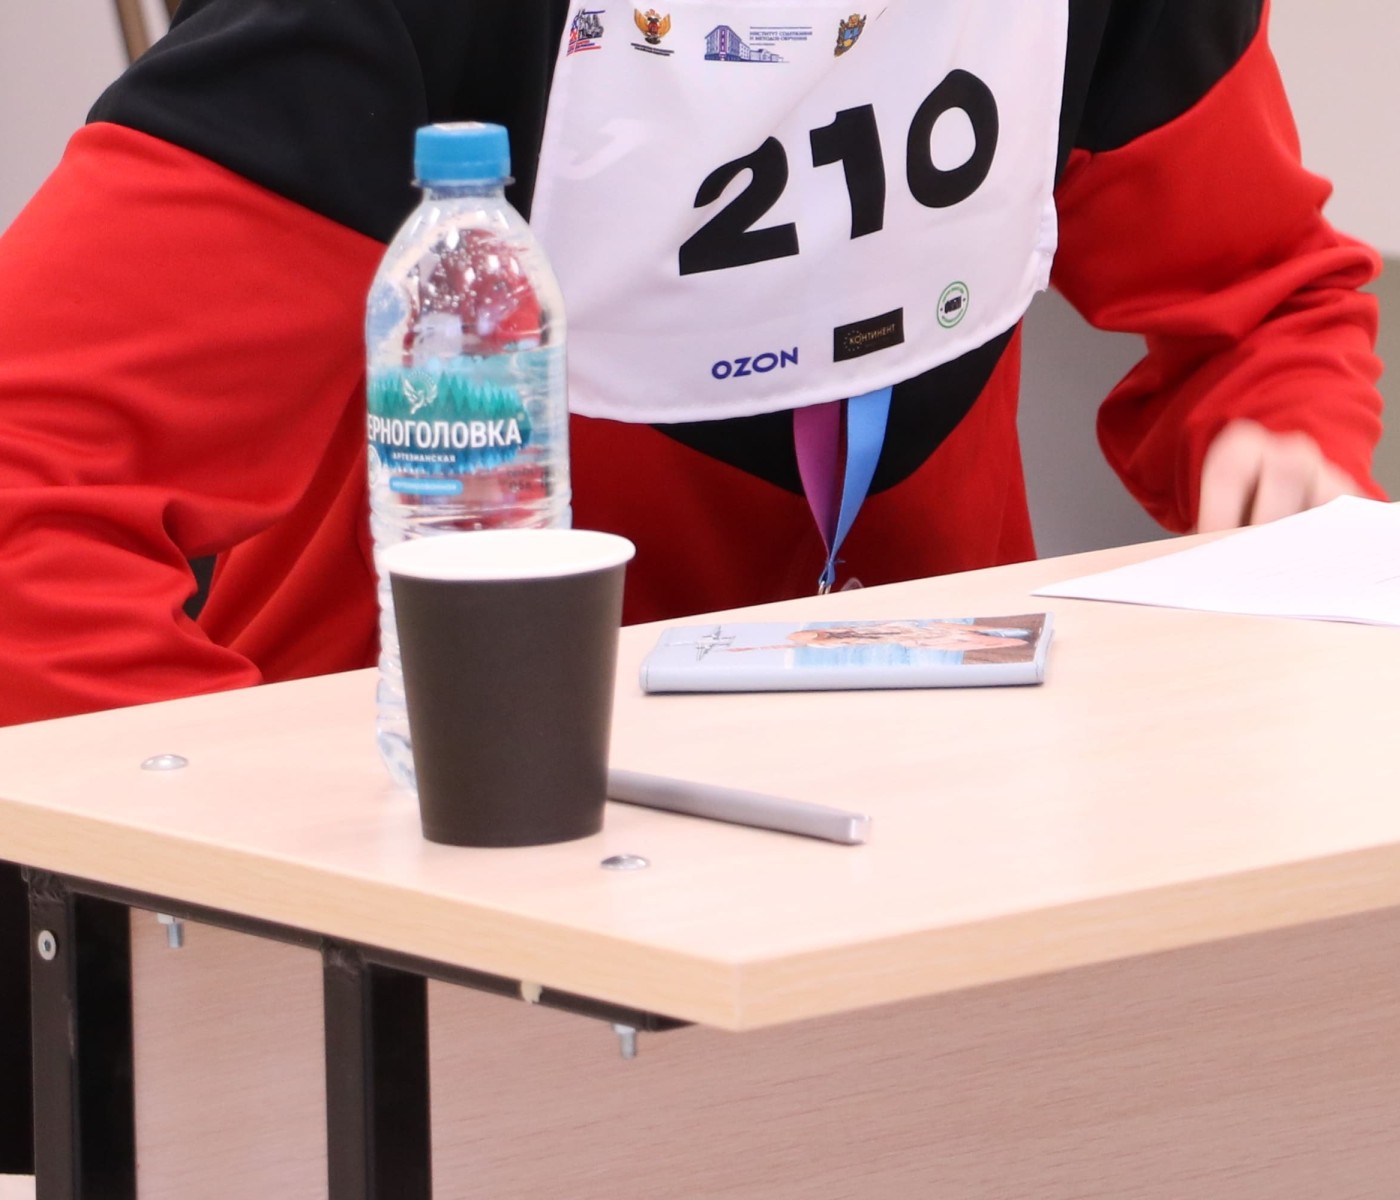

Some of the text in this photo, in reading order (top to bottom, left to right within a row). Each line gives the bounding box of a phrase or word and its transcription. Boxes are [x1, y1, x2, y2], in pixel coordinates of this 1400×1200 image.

[679, 68, 999, 276] 210
[848, 323, 896, 345] КОНТИНЕНТ
[711, 346, 798, 380] OZON
[368, 413, 522, 449] ЕРНОГОЛОВКА
